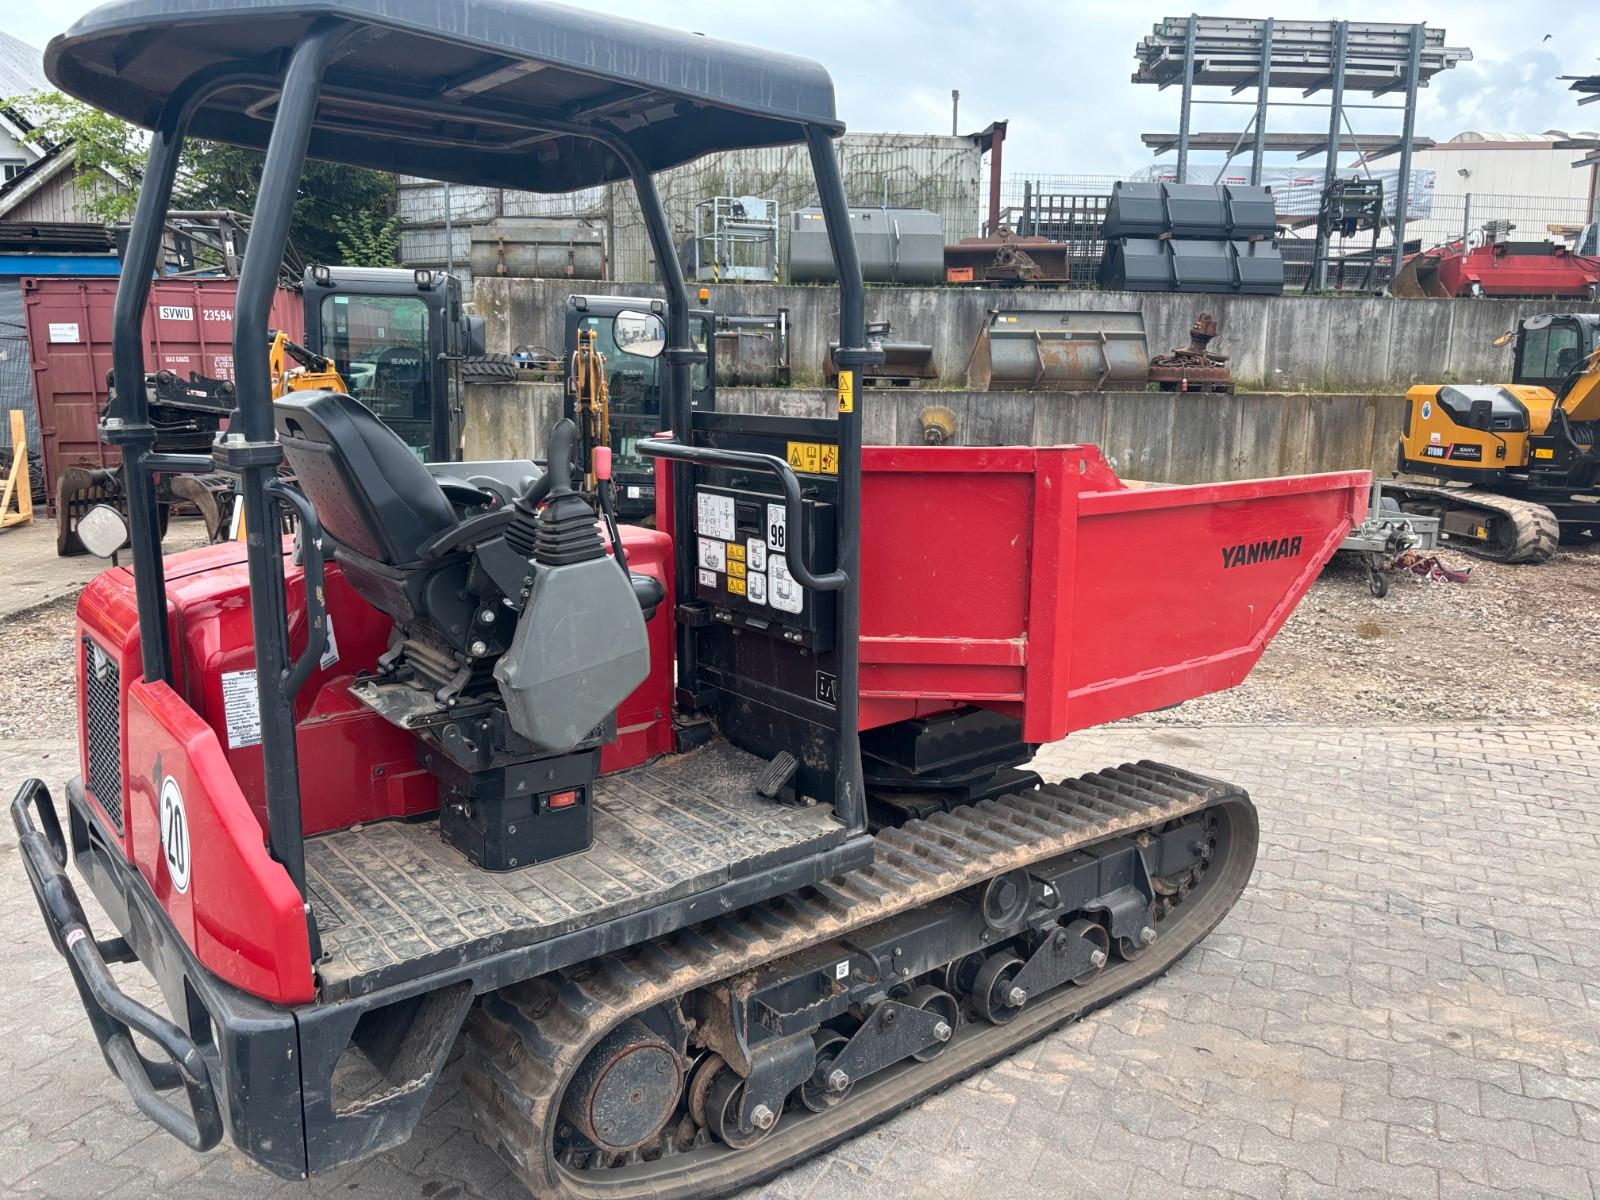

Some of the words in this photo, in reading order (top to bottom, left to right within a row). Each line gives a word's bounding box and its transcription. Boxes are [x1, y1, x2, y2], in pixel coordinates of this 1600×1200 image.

[163, 307, 190, 319] SVWU
[203, 309, 234, 321] 23594
[390, 358, 418, 366] SANY
[771, 524, 785, 548] 98
[1221, 535, 1303, 569] YANMAR
[165, 796, 185, 875] 20
